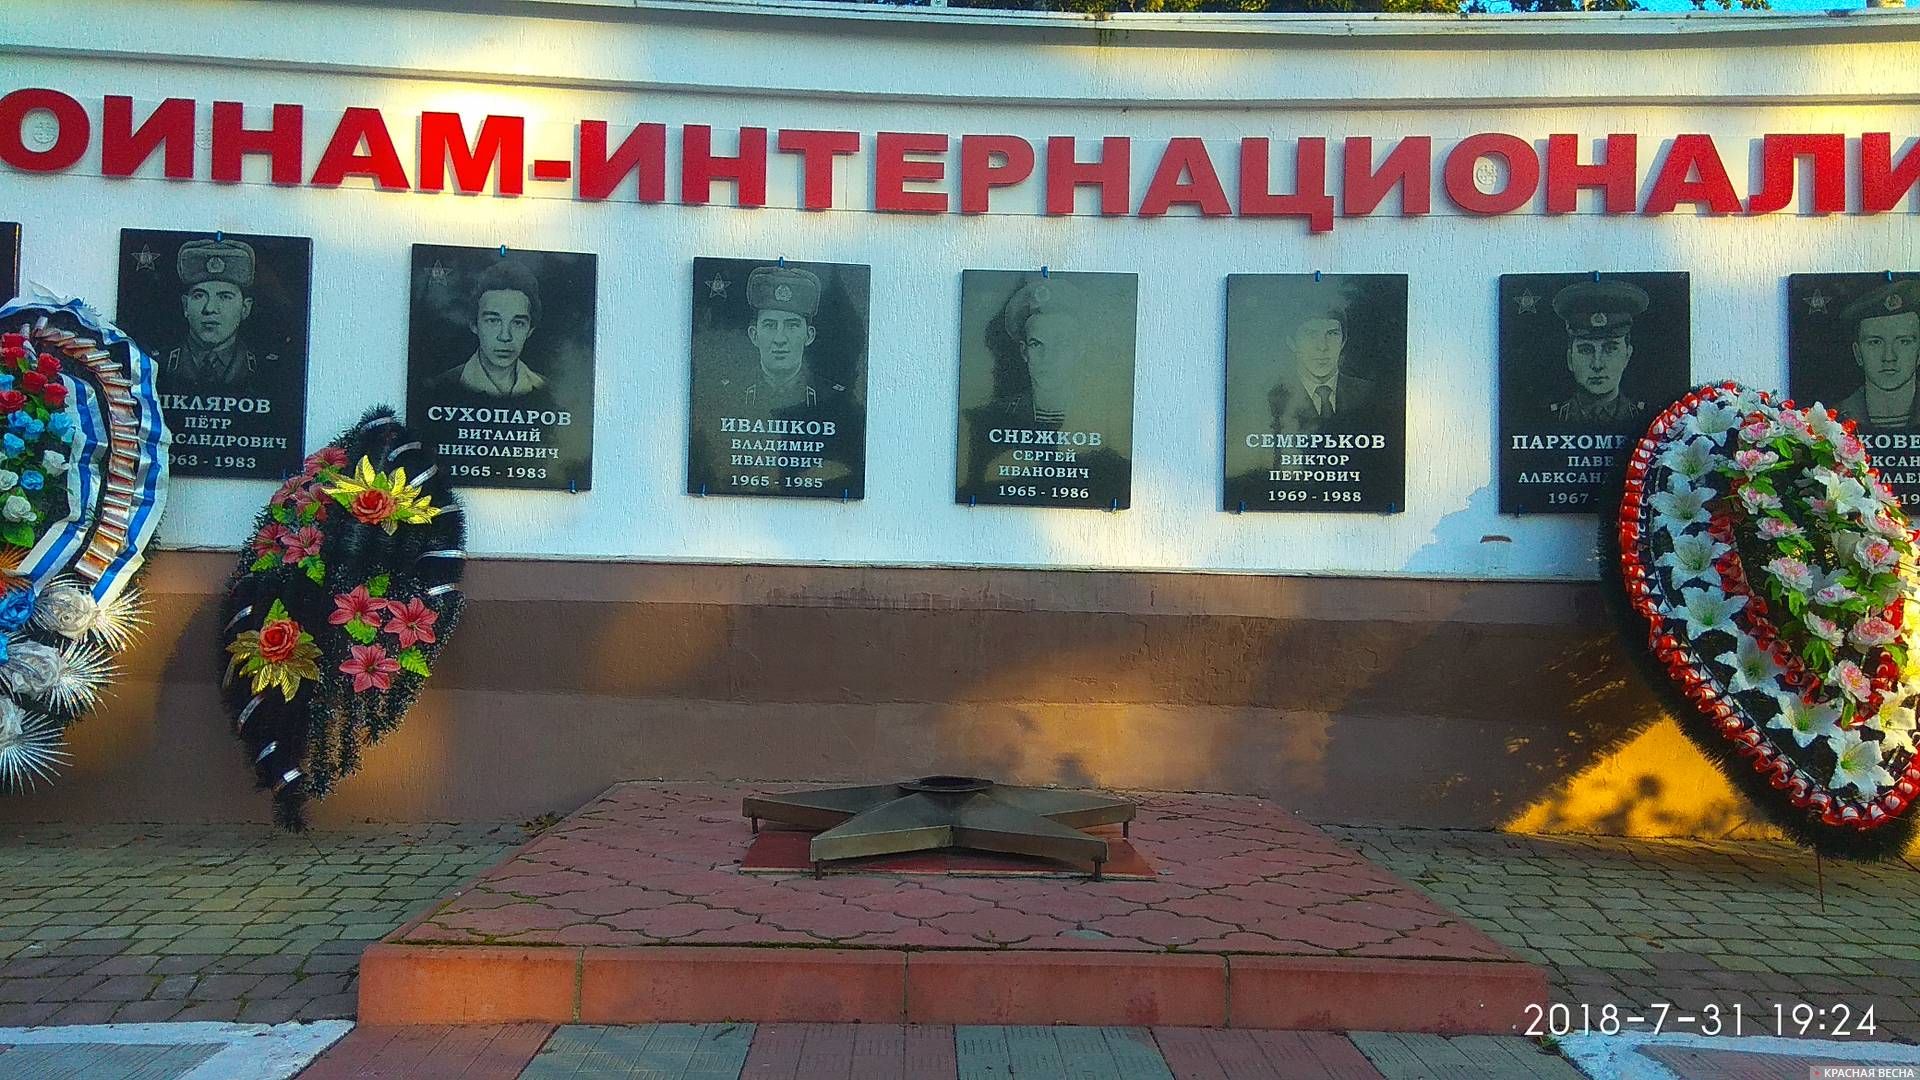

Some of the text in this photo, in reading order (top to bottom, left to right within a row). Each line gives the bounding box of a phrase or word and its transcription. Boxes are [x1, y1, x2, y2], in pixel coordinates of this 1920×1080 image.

[184, 415, 232, 430] ПЁТР
[427, 406, 571, 426] СУХОПАРОВ
[720, 417, 836, 436] ИВАШКОВ
[171, 433, 287, 449] САНДРОВИЧ
[457, 428, 541, 442] ВИТАЛИЙ
[989, 428, 1102, 446] СНЕЖКОВ
[1245, 433, 1386, 449] СЕМЕРЬКОВ
[438, 443, 559, 459] НИКОЛАЕВИЧ
[731, 439, 825, 452] ВЛАДИМИР
[730, 454, 824, 468] ИВАНОВИЧ
[1012, 448, 1077, 462] СЕРГЕЙ
[1280, 454, 1350, 466] ВИКТОР
[1868, 456, 1920, 467] КСАН
[215, 456, 256, 469] 1983
[450, 465, 491, 477] 1965
[506, 466, 547, 479] 1983
[999, 465, 1089, 479] ИВАНОВИЧ
[1268, 470, 1361, 482] ПЕТРОВИЧ
[731, 475, 770, 486] 1965
[785, 477, 823, 488] 1985
[999, 485, 1037, 497] 1965
[1051, 487, 1089, 498] 1986
[1268, 490, 1307, 502] 1969
[1323, 491, 1362, 502] 1988
[1548, 493, 1589, 504] 1967
